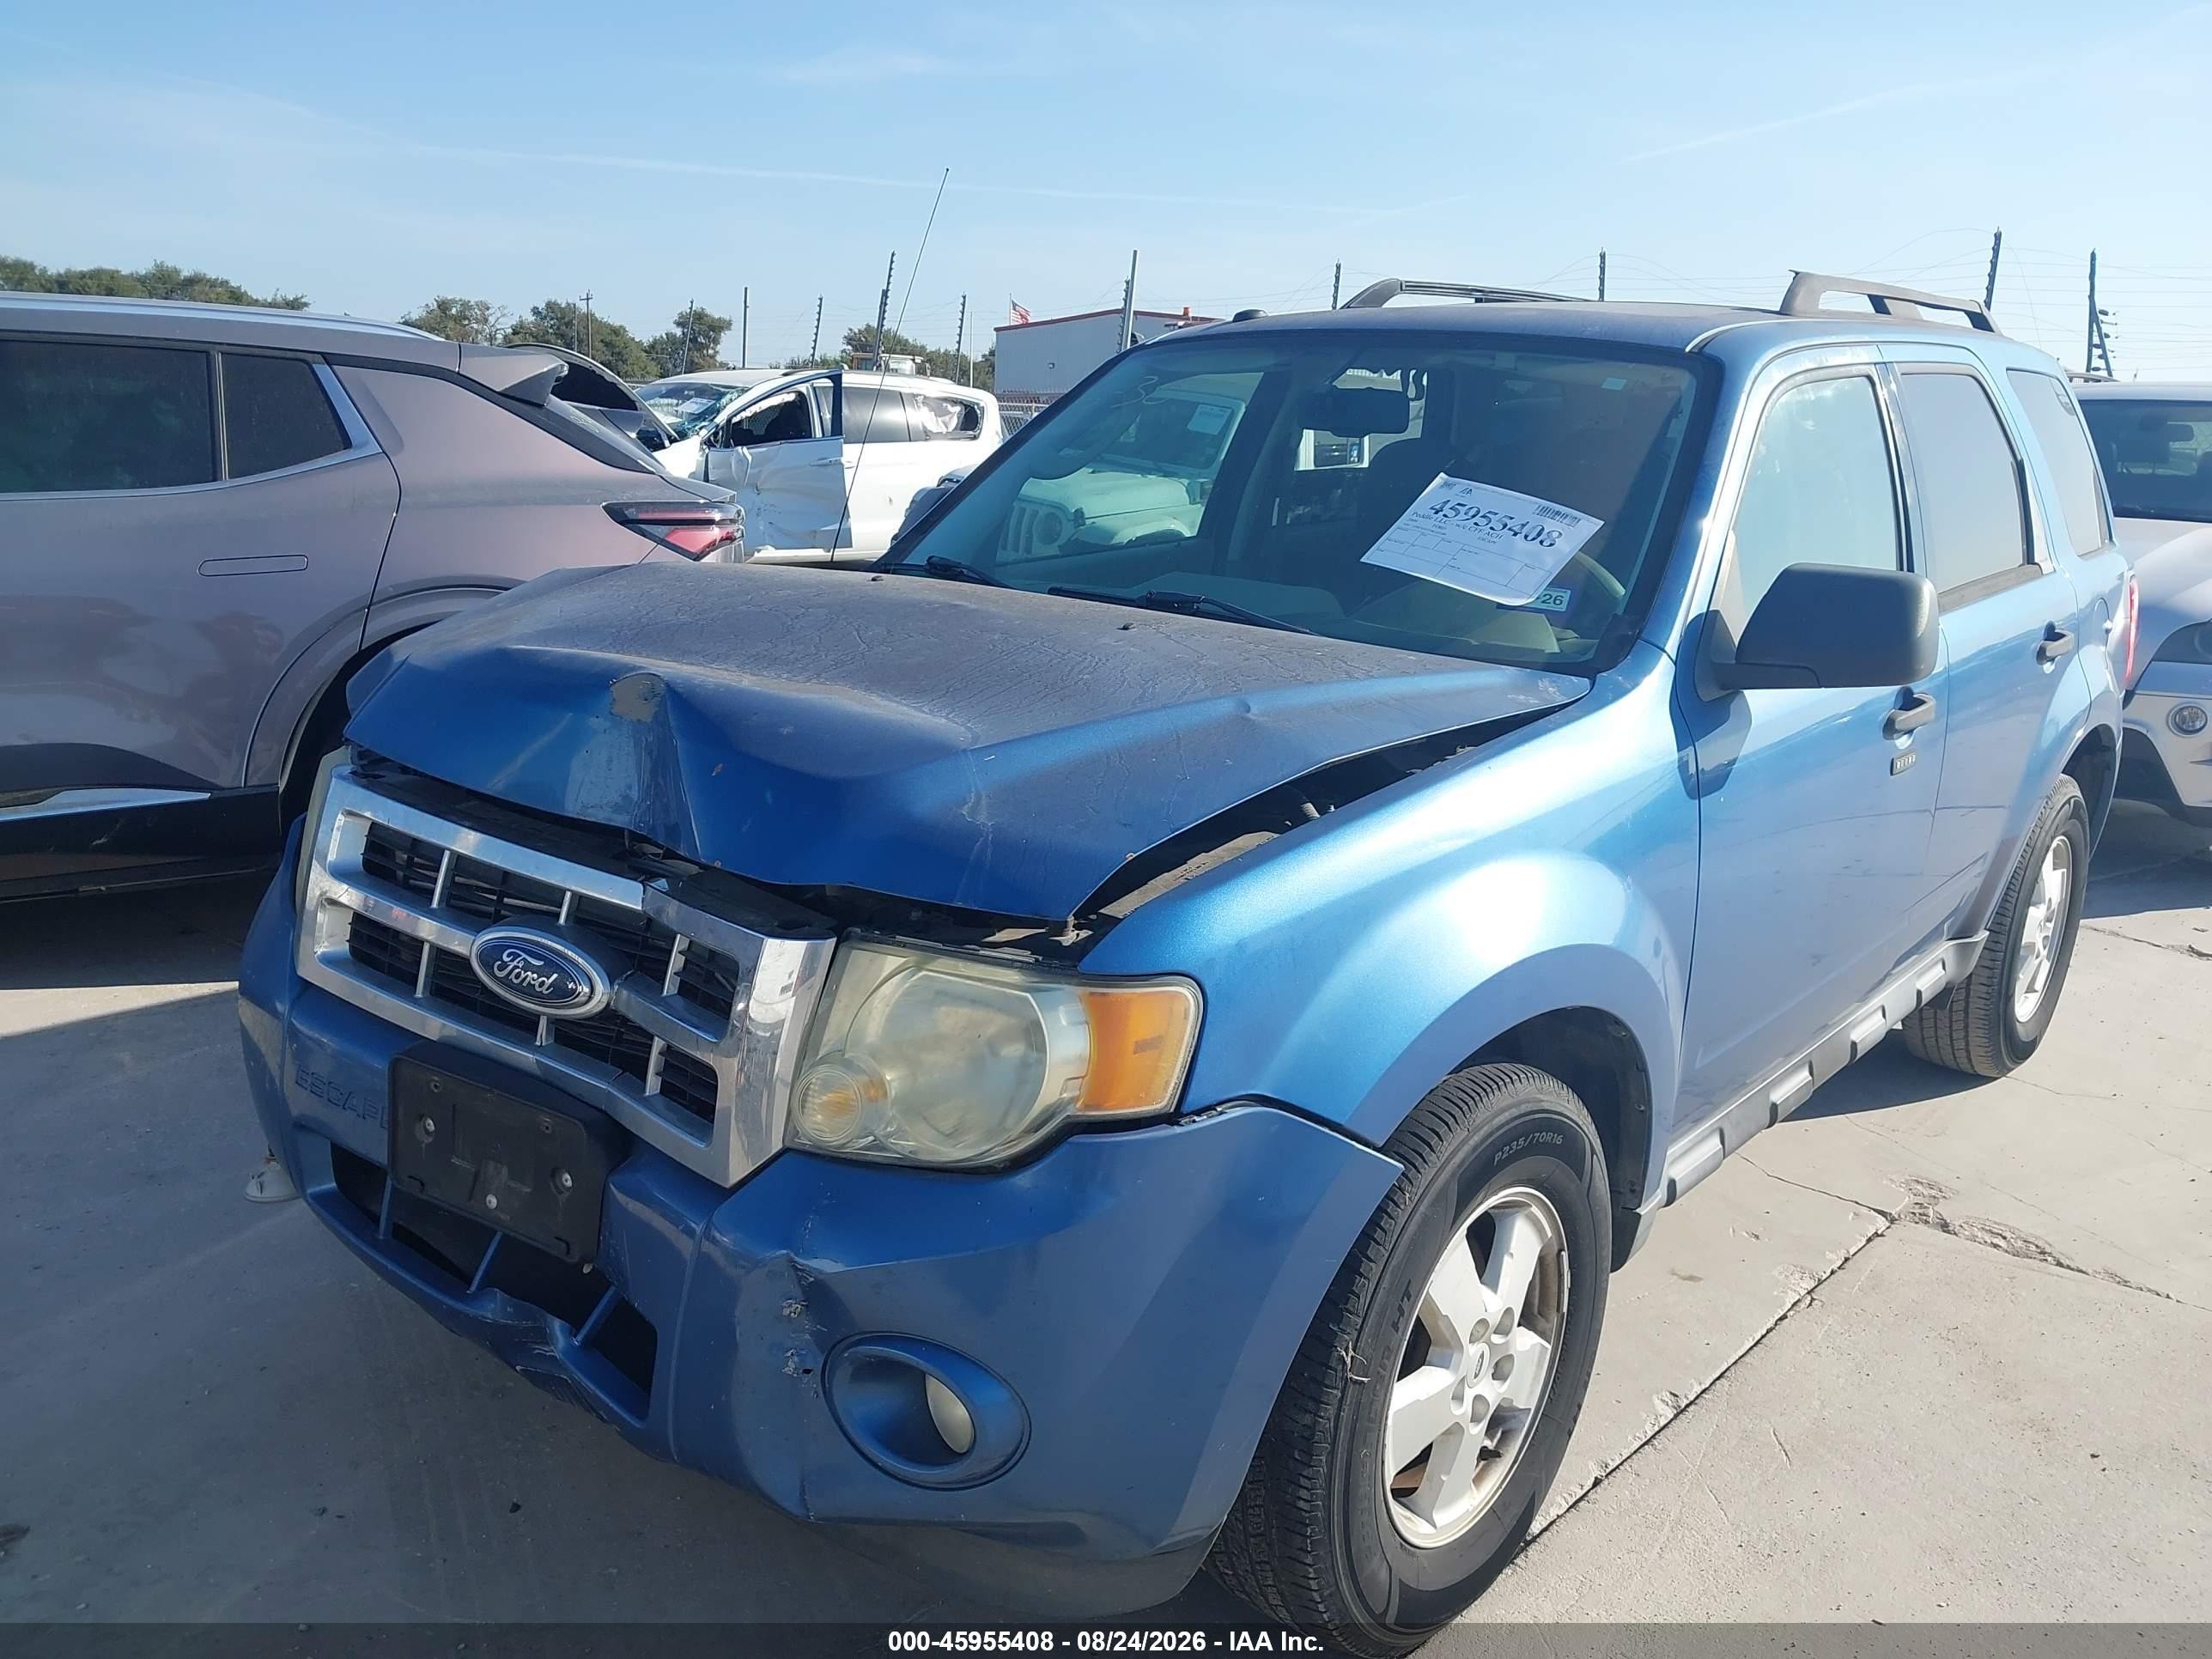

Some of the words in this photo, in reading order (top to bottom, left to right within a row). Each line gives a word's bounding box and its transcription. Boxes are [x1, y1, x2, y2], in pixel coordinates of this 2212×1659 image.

[1429, 499, 1563, 548] 45955408
[493, 948, 558, 994] Ford
[1493, 1132, 1564, 1166] P235/70R16
